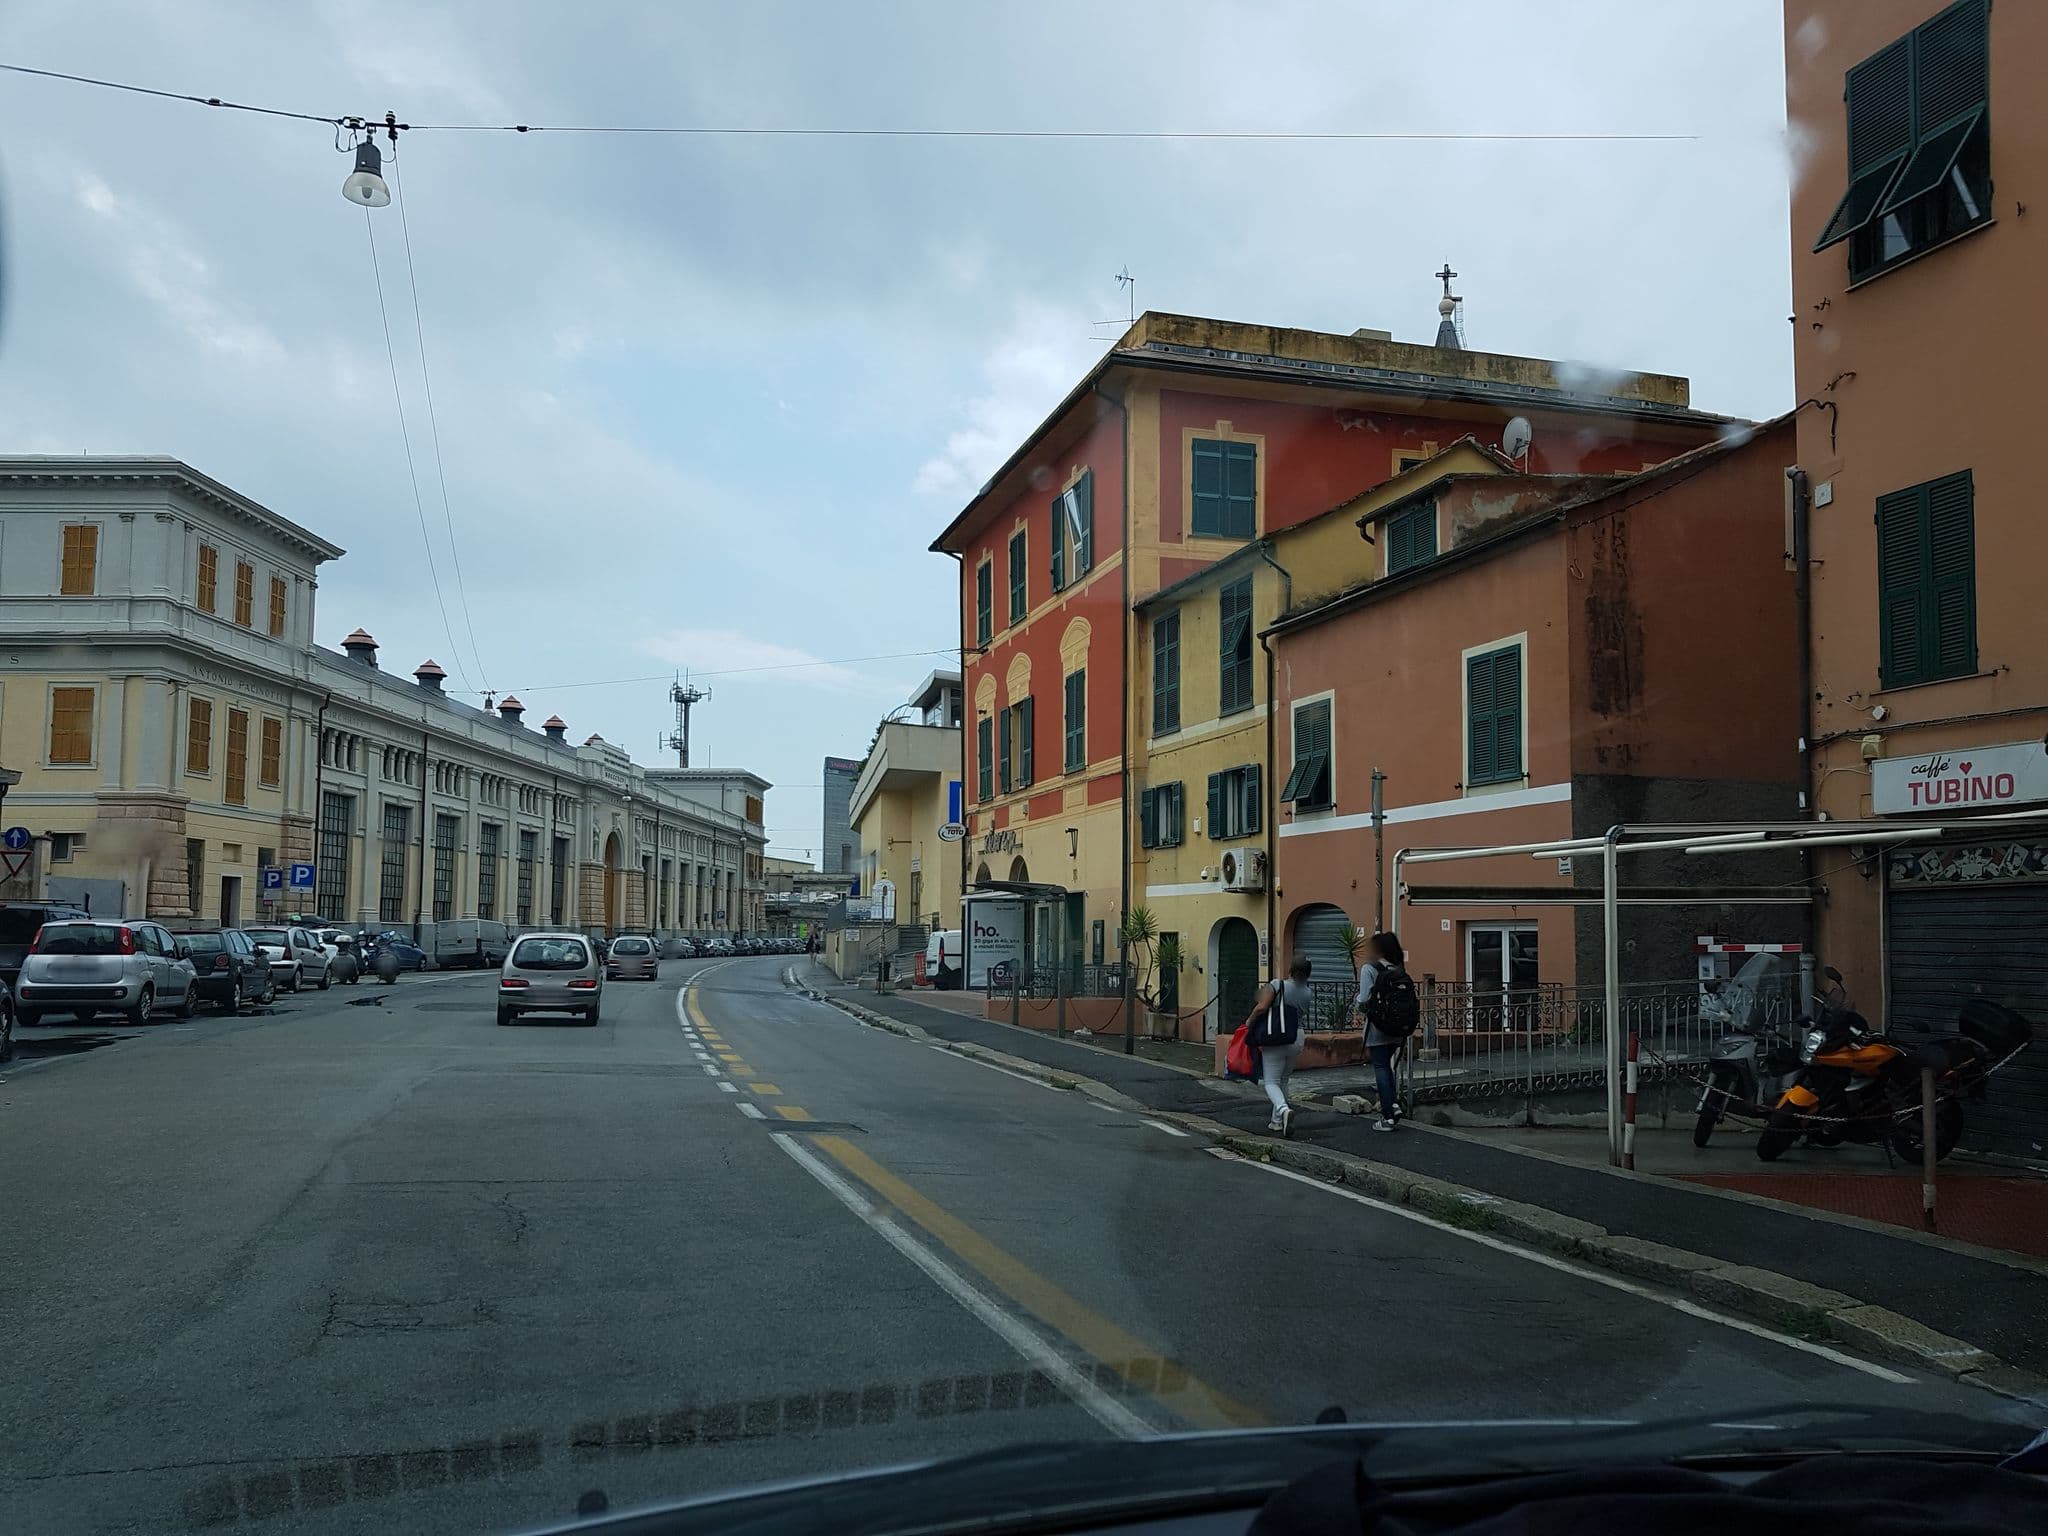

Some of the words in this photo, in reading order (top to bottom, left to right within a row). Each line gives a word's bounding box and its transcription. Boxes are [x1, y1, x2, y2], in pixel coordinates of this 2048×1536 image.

[192, 665, 233, 686] ANTONIO
[1908, 773, 2015, 806] TUBINO
[267, 872, 280, 887] P
[295, 866, 310, 883] P
